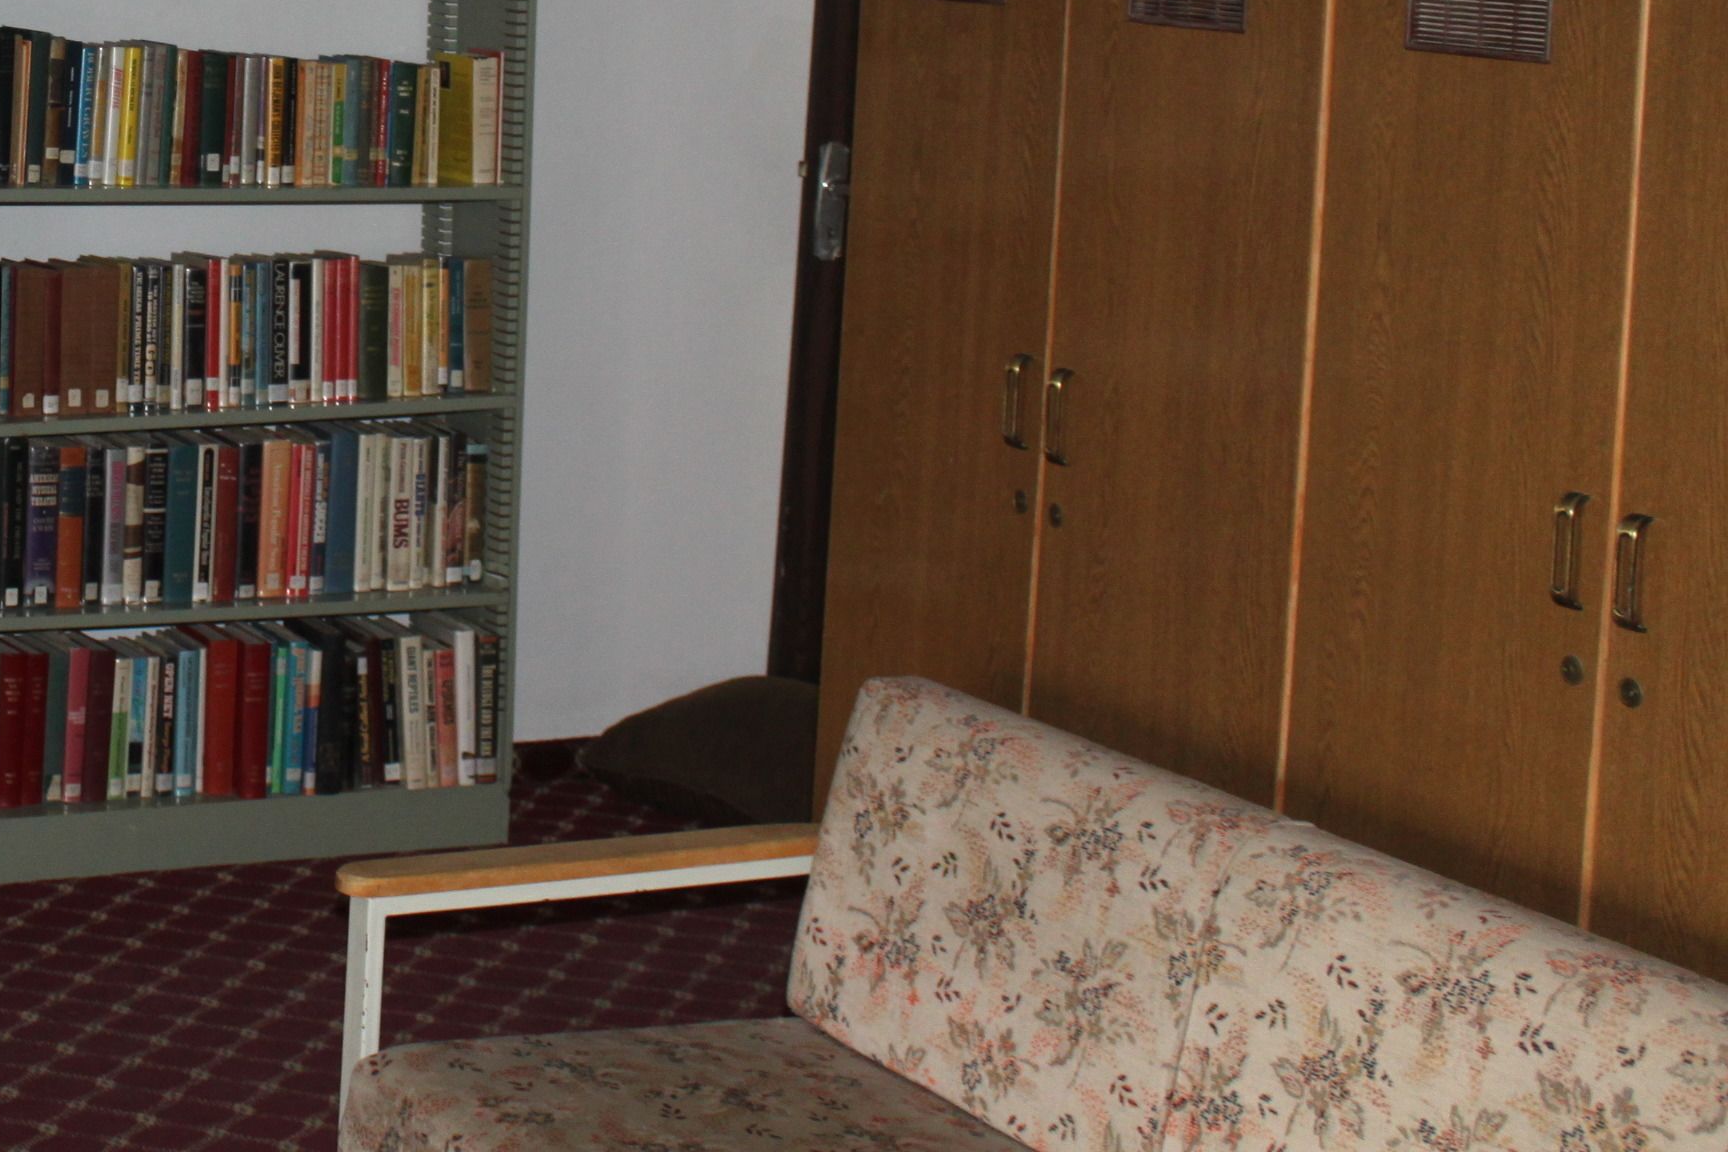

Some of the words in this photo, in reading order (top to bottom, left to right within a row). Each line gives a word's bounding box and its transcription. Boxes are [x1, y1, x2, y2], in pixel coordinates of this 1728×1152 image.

[274, 263, 285, 331] LAURENCE
[393, 498, 410, 548] BUMS
[164, 663, 175, 693] OPEN
[163, 695, 174, 719] NET
